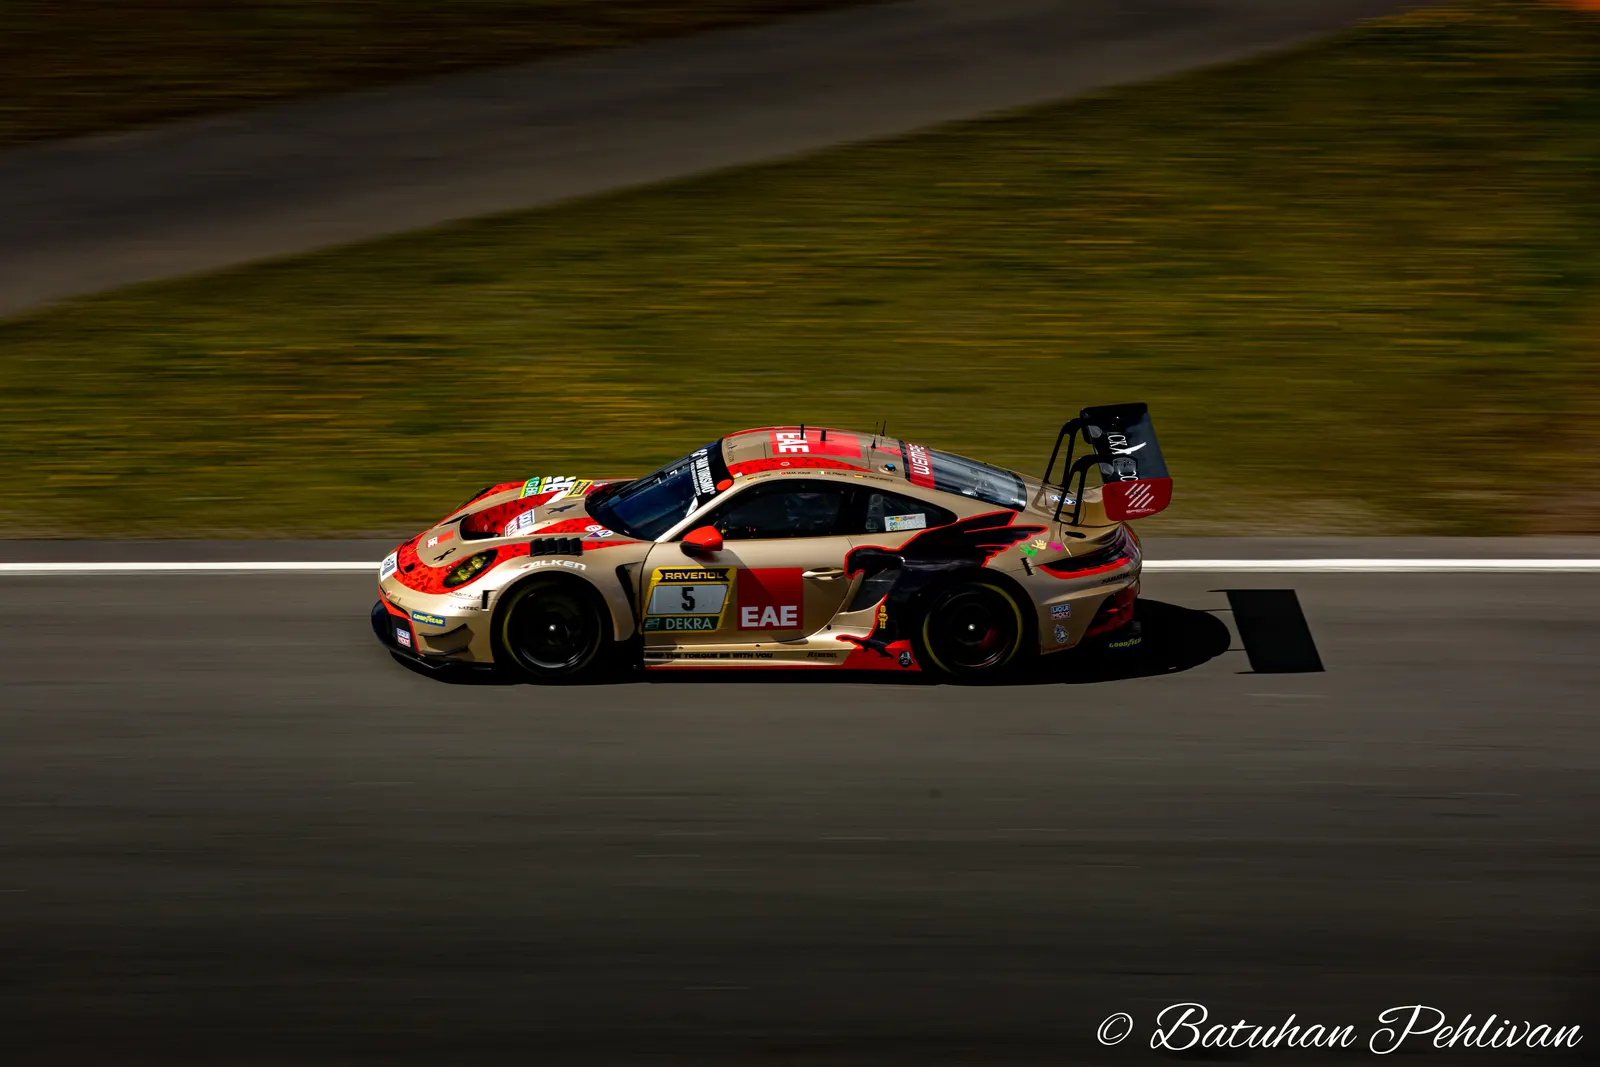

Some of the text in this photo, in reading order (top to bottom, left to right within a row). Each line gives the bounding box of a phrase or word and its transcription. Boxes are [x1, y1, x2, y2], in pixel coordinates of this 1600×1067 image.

[776, 432, 810, 453] EAE
[908, 443, 930, 475] WEMPE
[665, 571, 723, 580] RAVENOL
[681, 587, 695, 611] 5
[665, 618, 713, 630] DEKRA
[741, 605, 798, 628] EAE
